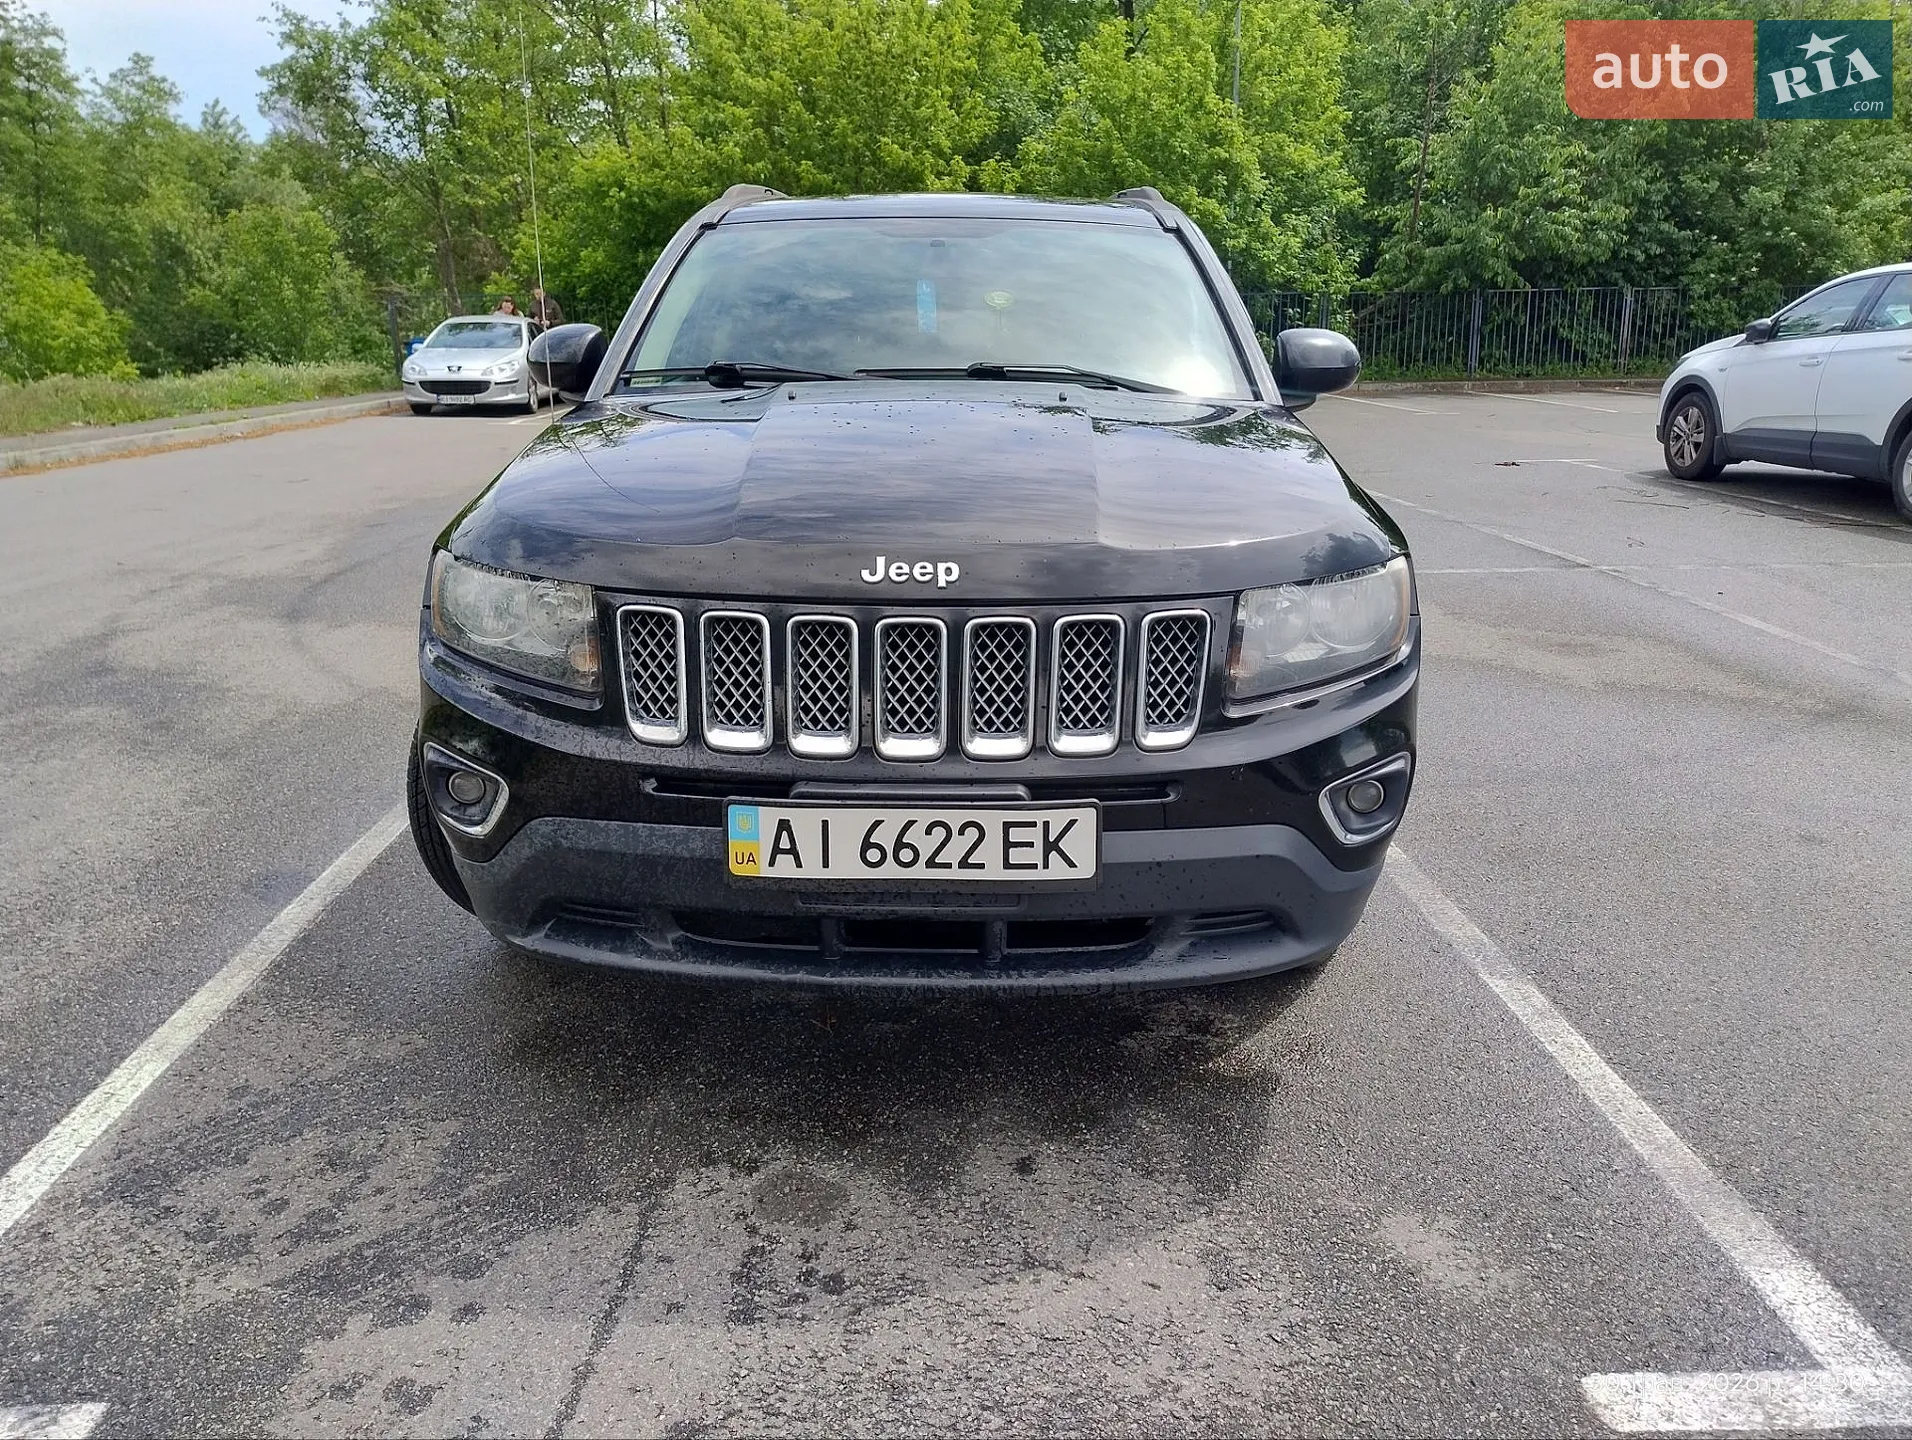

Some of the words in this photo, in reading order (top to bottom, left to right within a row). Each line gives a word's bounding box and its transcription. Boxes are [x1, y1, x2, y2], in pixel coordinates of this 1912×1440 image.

[860, 555, 960, 589] Jeep
[734, 851, 758, 866] UA
[767, 818, 830, 869] AI
[859, 819, 987, 869] 6622
[1002, 818, 1079, 870] EK
